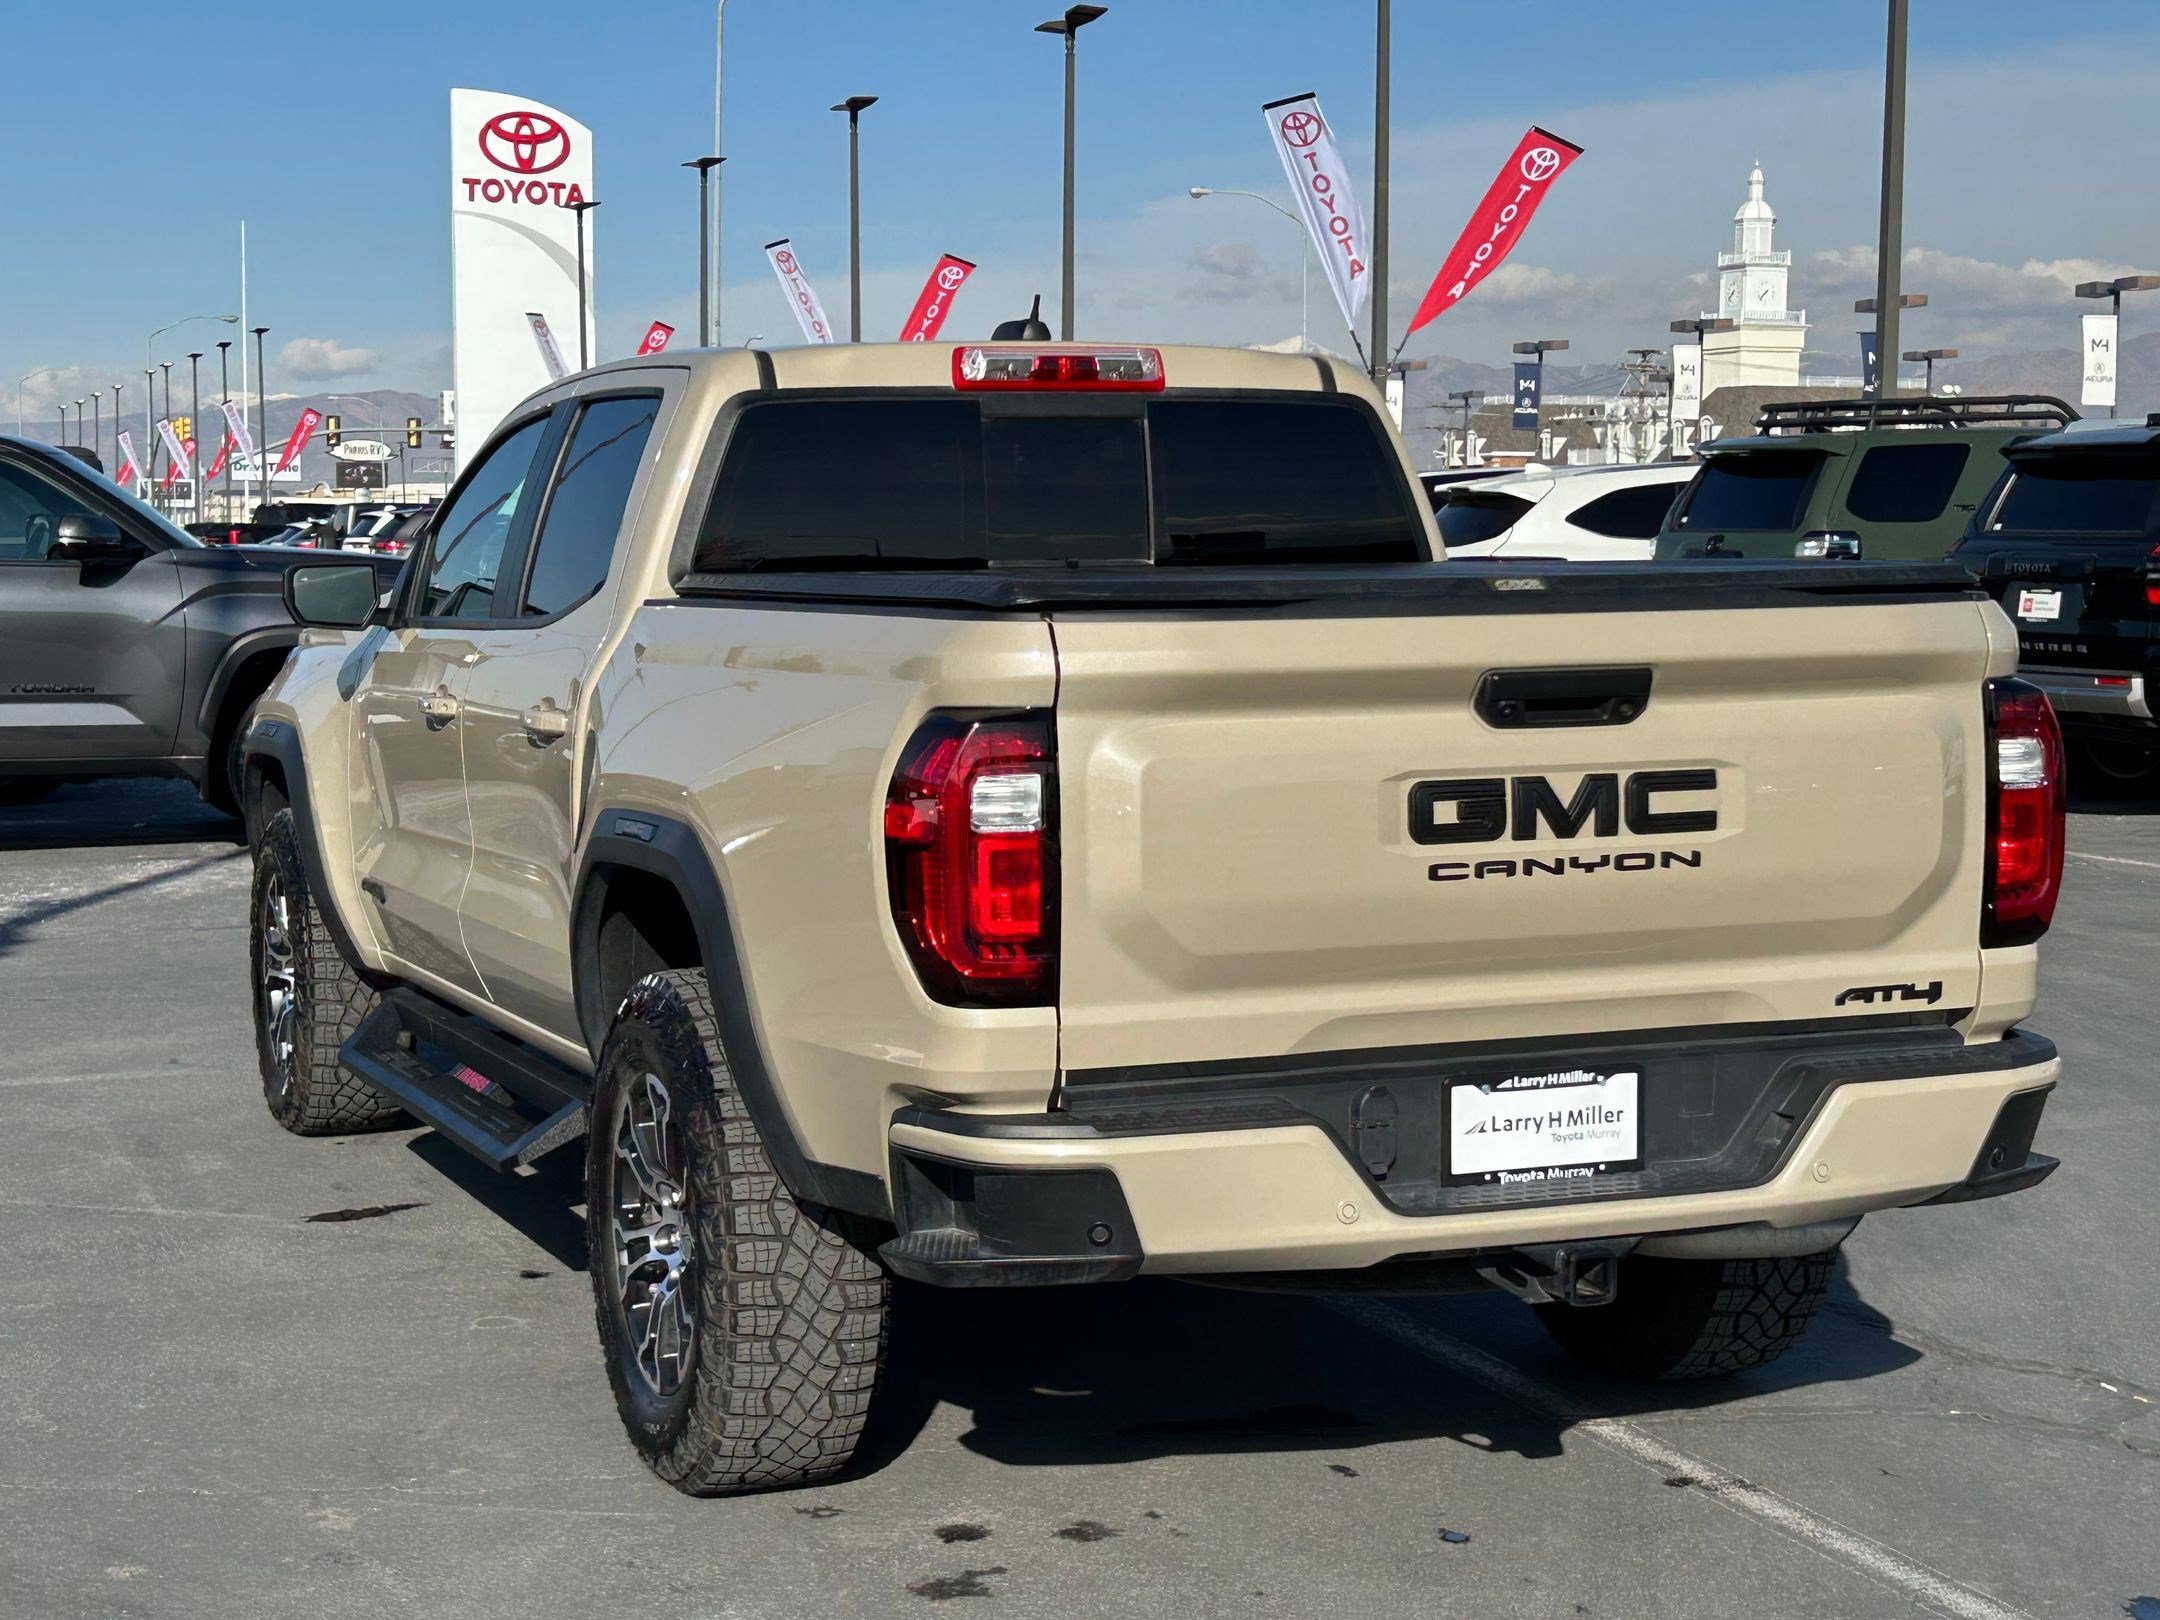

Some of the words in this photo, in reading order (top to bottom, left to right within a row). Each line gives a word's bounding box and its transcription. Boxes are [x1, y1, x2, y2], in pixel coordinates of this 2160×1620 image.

[462, 178, 585, 208] TOYOTA
[1303, 151, 1365, 280] TOYOTA
[1447, 184, 1532, 299] TOYOTA
[791, 277, 827, 344] TOYOT
[912, 291, 947, 342] TOYO
[2013, 562, 2052, 573] TOYOTA
[1407, 769, 1718, 846] GMC
[1428, 850, 1702, 882] CANYON
[1835, 981, 1943, 1006] AT4
[1513, 1074, 1547, 1088] Larry
[1548, 1073, 1559, 1085] H
[1559, 1069, 1596, 1084] Miller
[1491, 1114, 1544, 1134] Larry
[1548, 1111, 1562, 1129] H
[1566, 1105, 1624, 1128] Miller
[1551, 1132, 1585, 1144] Toyota
[1586, 1128, 1621, 1140] Murray
[1497, 1169, 1545, 1185] Toyota
[1547, 1166, 1595, 1181] Murray
